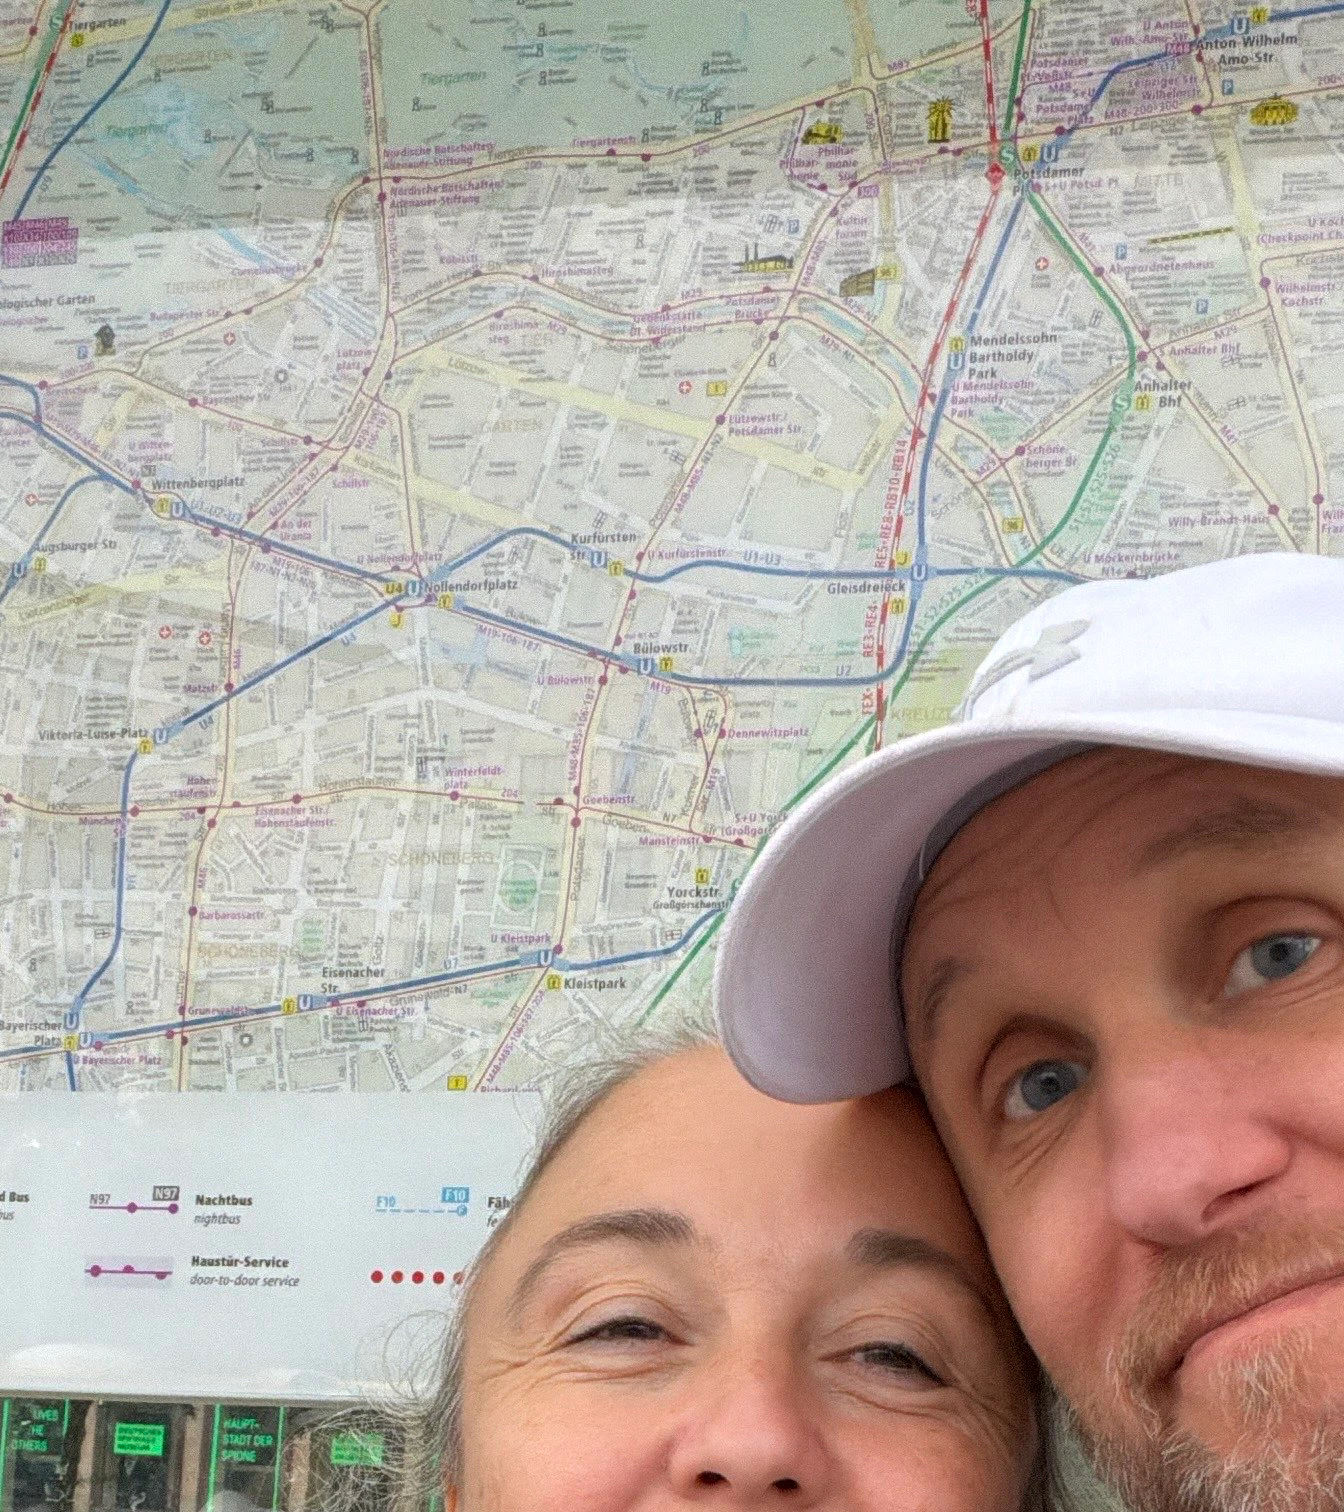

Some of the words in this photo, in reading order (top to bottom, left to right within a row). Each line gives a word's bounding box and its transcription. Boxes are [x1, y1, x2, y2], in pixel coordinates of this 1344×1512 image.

[68, 16, 126, 32] Tiergarten
[1196, 36, 1239, 51] Anton
[1242, 32, 1297, 47] Wilhelm
[1014, 166, 1085, 180] Potsdamer
[57, 293, 95, 306] Garten
[969, 350, 1034, 364] Bartholdy
[968, 368, 998, 380] Park
[1134, 379, 1193, 393] Anhalter
[1159, 394, 1183, 408] Bhf
[951, 408, 975, 418] Park
[151, 476, 245, 491] Wittenbergplatz
[1168, 513, 1272, 528] Willy-Brandt-Haus
[1094, 551, 1182, 563] Möckernbrücke
[425, 578, 519, 594] Nollendorfplatz
[827, 580, 906, 596] Gleisdreieck
[38, 729, 149, 741] Viktoria-Luise-Platz
[321, 966, 386, 981] Eisenacher
[563, 976, 627, 992] Kleistpark
[34, 1035, 63, 1047] Platz
[10, 1192, 30, 1202] Bus
[90, 1194, 110, 1205] N97
[156, 1188, 177, 1199] N97
[196, 1195, 252, 1206] Nachtbus
[194, 1214, 241, 1227] nightbus
[192, 1256, 289, 1268] Haustür-Service
[191, 1275, 259, 1286] door-to-door
[263, 1276, 299, 1286] service
[223, 1435, 252, 1446] STADT
